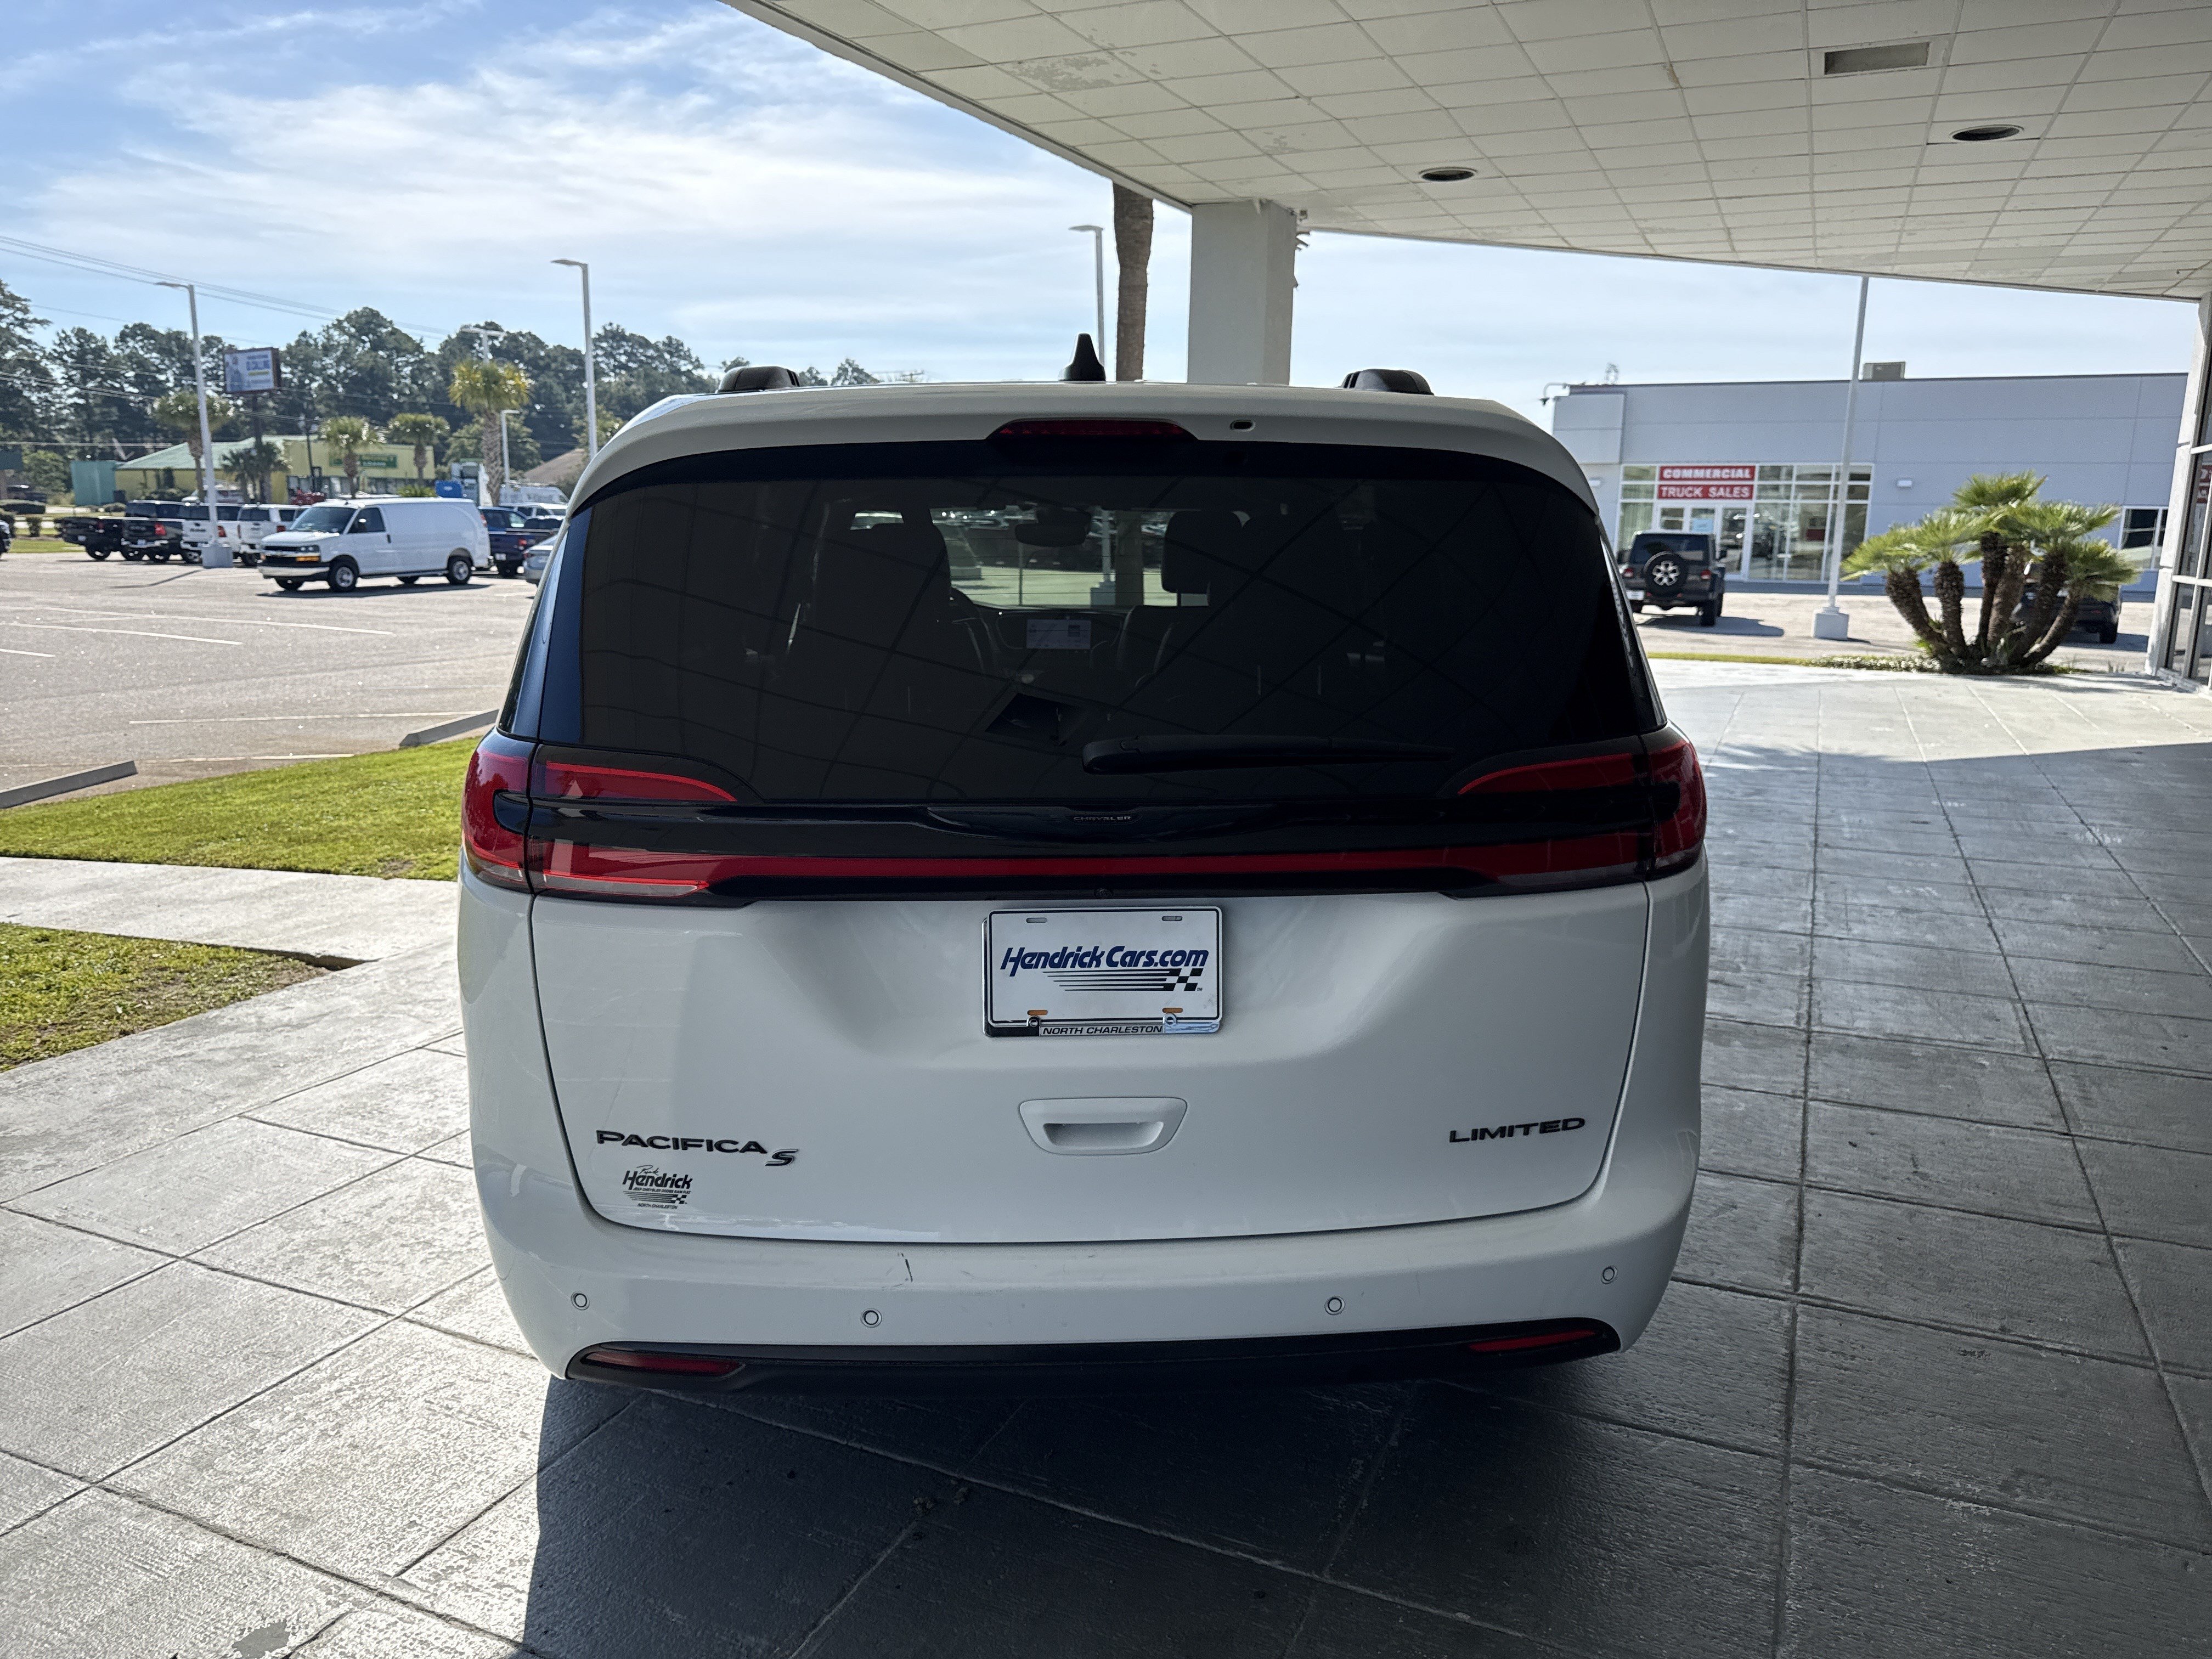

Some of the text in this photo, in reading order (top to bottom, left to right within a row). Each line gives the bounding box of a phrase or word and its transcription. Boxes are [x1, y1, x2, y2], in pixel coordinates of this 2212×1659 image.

[1662, 468, 1751, 479] COMMERCIAL
[1660, 486, 1750, 499] TRUCK SALES
[1086, 1025, 1163, 1034] CHARLESTON
[1449, 1118, 1585, 1143] LIMITED
[596, 1130, 799, 1167] PACIFICA S
[622, 1170, 693, 1190] Hendrick
